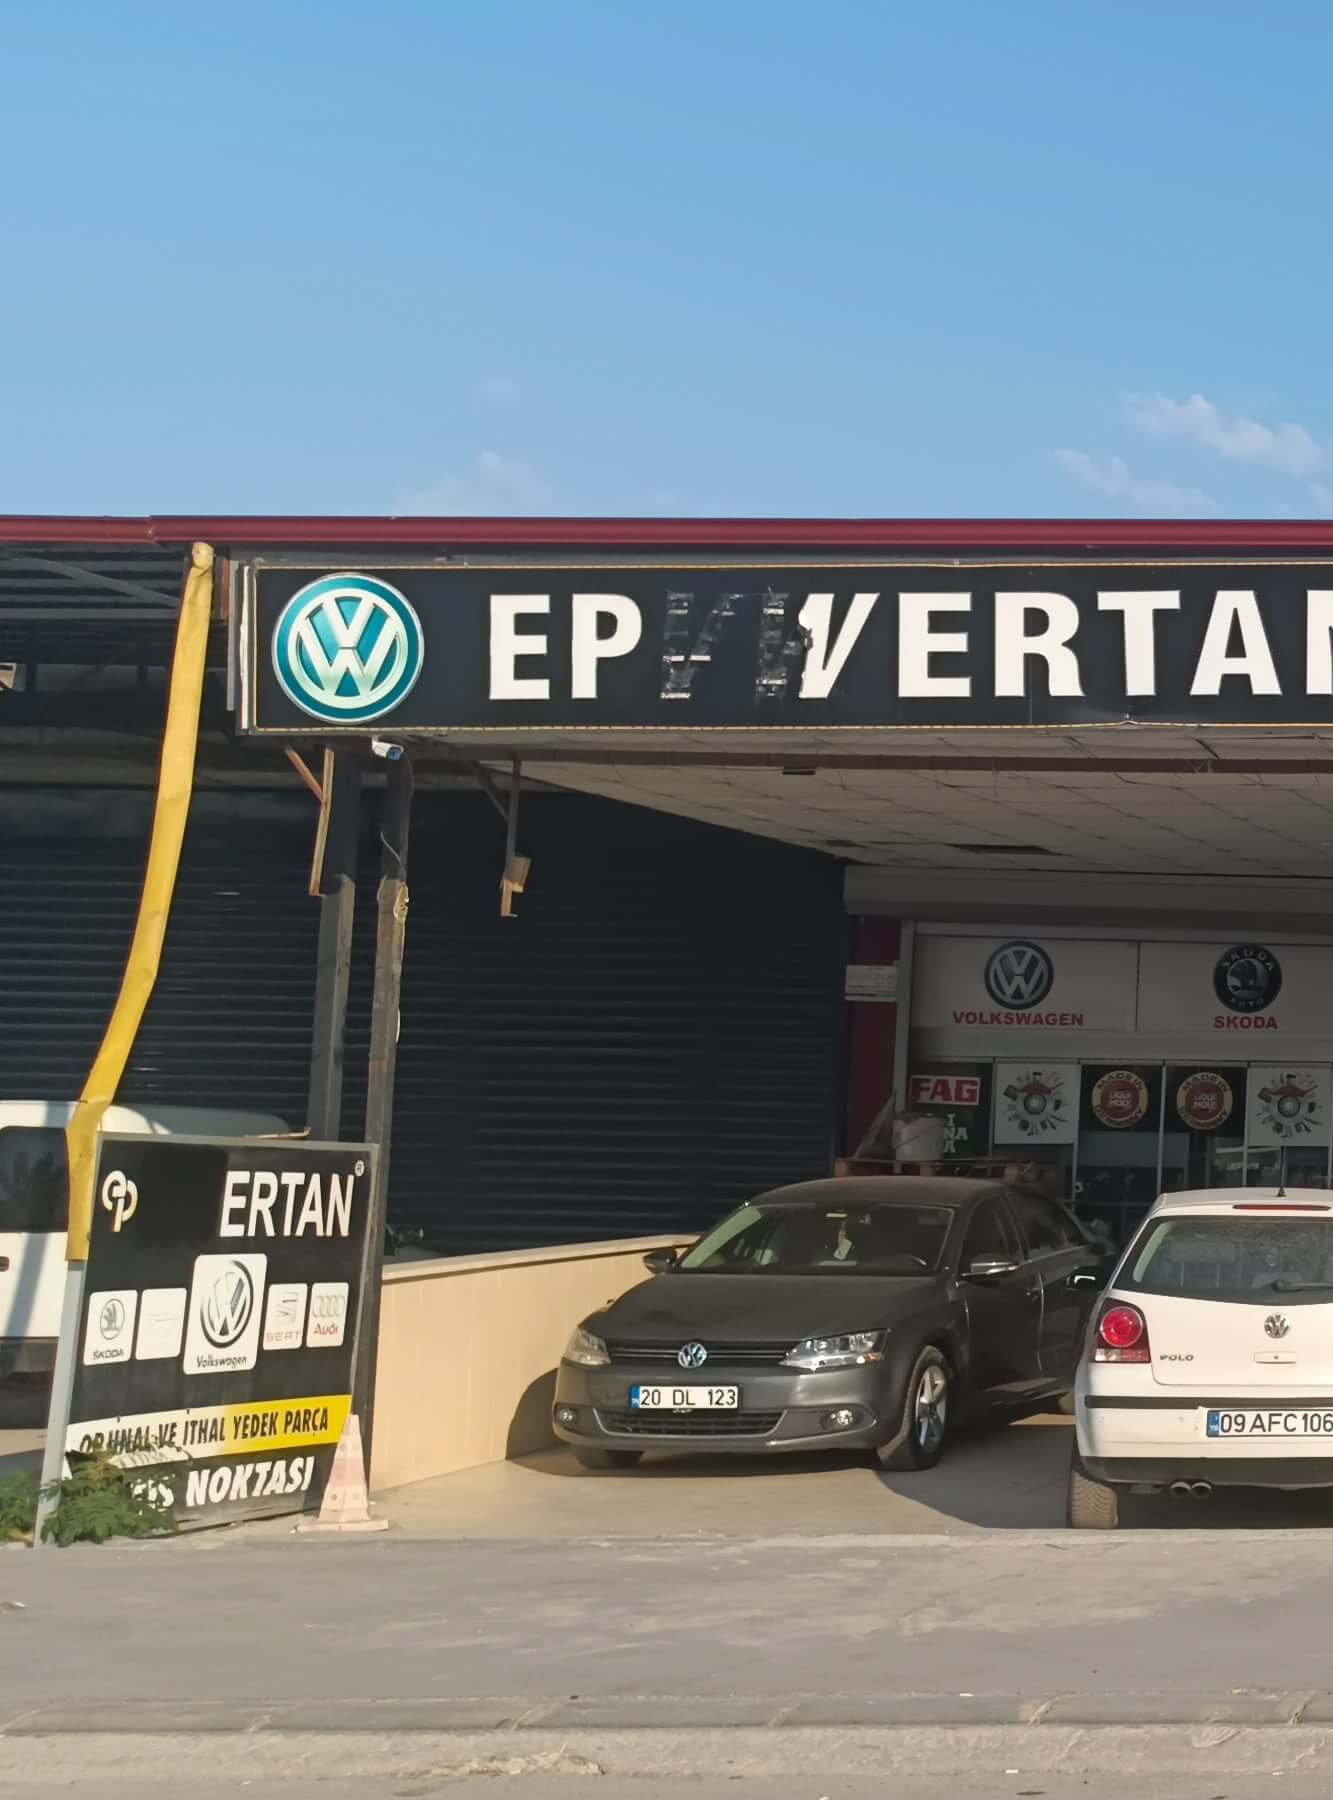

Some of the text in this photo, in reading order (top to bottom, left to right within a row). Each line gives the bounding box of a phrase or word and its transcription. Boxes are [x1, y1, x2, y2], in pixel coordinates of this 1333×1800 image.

[489, 594, 642, 700] EP
[952, 1011, 1084, 1027] VOLKSWAGEN
[1214, 1014, 1279, 1029] SKODA
[912, 1078, 978, 1103] FAG
[219, 1170, 355, 1238] ERTAN
[196, 1355, 247, 1371] Volkswagen
[641, 1389, 737, 1406] 20 DL 123
[233, 1411, 279, 1440] YEDEK
[283, 1407, 329, 1436] PARÇA
[1220, 1413, 1246, 1433] 09
[1249, 1413, 1298, 1433] AFC
[186, 1456, 315, 1507] NOKTASI
